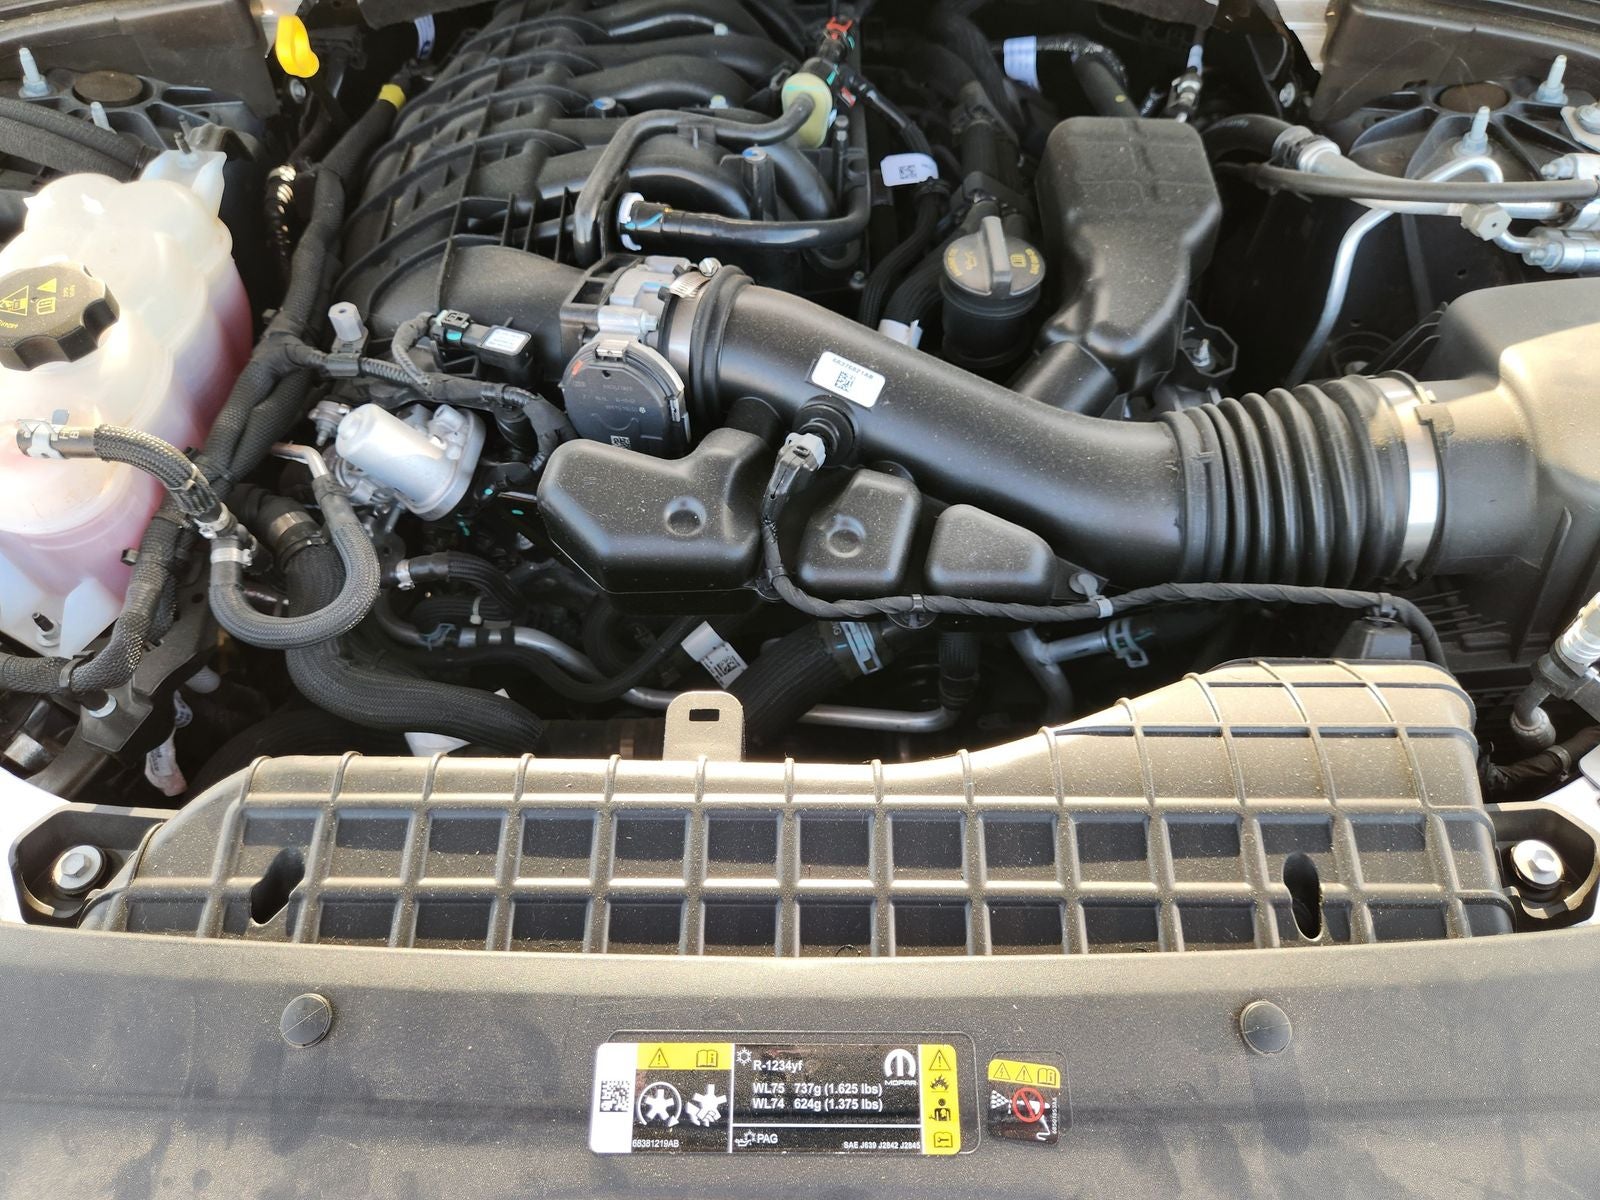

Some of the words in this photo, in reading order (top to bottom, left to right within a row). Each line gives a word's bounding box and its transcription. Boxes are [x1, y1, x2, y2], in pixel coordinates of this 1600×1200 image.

[753, 1060, 803, 1073] R-1234yf
[753, 1083, 785, 1094] WL75
[794, 1083, 822, 1096] 737g
[824, 1083, 859, 1096] (1.625
[861, 1083, 883, 1097] lbs)
[753, 1098, 785, 1109] WL74
[794, 1098, 822, 1112] 624g
[824, 1098, 859, 1112] (1.375
[861, 1098, 883, 1112] lbs)
[632, 1139, 680, 1148] 68381219AB
[757, 1133, 779, 1144] PAG
[843, 1141, 859, 1149] SAE
[860, 1141, 877, 1149] J639
[878, 1141, 899, 1149] J2842
[900, 1141, 921, 1149] J2845
